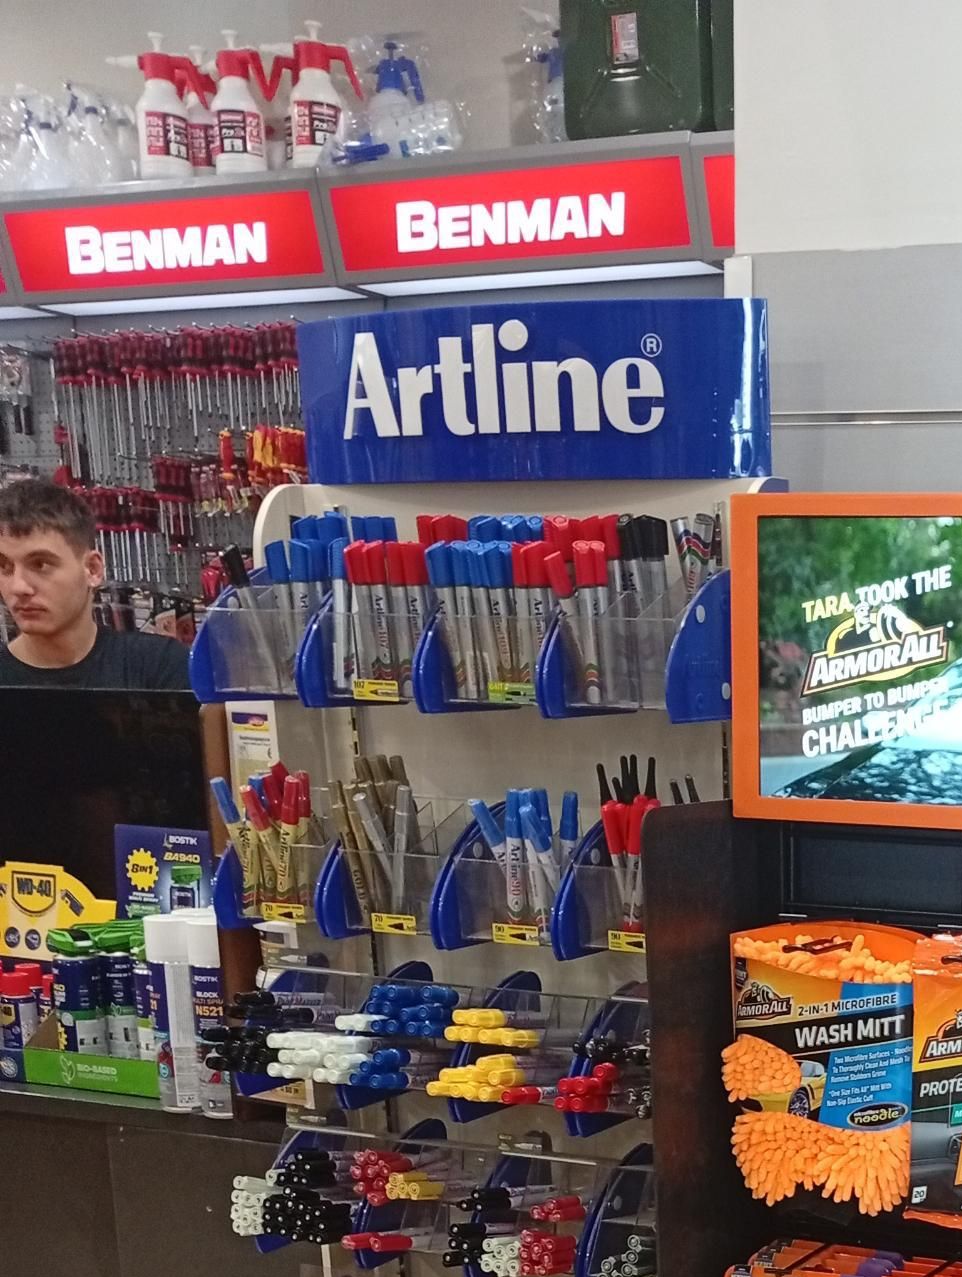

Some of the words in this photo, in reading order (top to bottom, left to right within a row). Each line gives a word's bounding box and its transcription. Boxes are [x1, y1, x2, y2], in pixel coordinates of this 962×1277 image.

[396, 191, 625, 253] BENMAN
[65, 221, 267, 275] BENMAN
[343, 319, 665, 441] Artline
[802, 592, 853, 623] TARA
[856, 576, 909, 606] TOOK
[912, 565, 952, 595] THE
[803, 696, 862, 726] BUMPER
[864, 691, 885, 710] TO
[168, 835, 198, 846] BOSTIK
[16, 877, 52, 897] WD-40
[798, 1004, 830, 1017] 2-IN-1
[831, 993, 897, 1012] MICROFIBRE
[795, 1022, 854, 1048] WASH
[857, 1015, 905, 1041] MITT
[869, 1050, 891, 1060] Surfaces
[838, 1063, 864, 1074] Thoroughly
[842, 1088, 853, 1097] Size
[853, 1087, 861, 1095] Fits
[854, 1108, 900, 1126] noodle
[914, 1189, 925, 1198] 20
